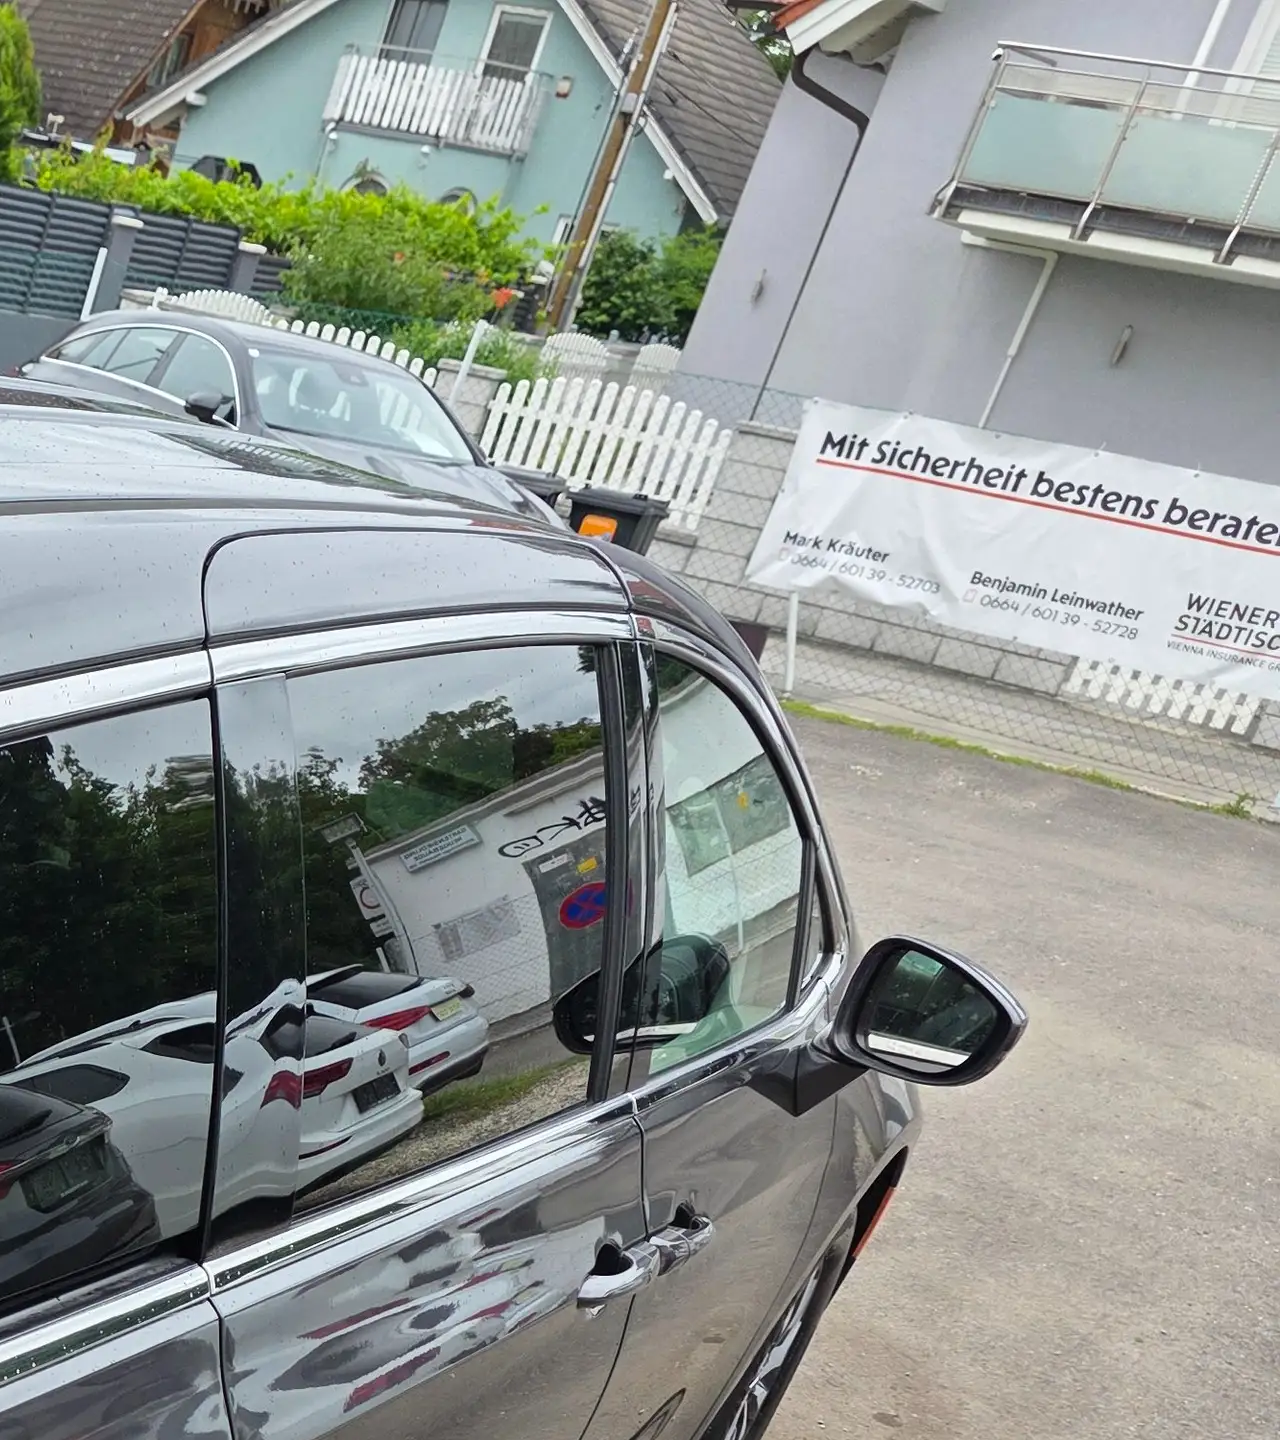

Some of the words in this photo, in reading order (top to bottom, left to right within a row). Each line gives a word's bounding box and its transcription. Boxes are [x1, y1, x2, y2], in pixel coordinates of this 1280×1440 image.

[819, 431, 870, 461] Mit
[870, 440, 1028, 493] Sicherheit
[1030, 471, 1159, 520] bestens
[1162, 497, 1280, 547] berate
[783, 530, 822, 550] Mark
[826, 538, 890, 563] Kräuter
[866, 567, 887, 582] 39
[896, 574, 941, 594] 52703
[969, 570, 1048, 600] Benjamin
[1050, 588, 1144, 621] Leinwather
[980, 594, 1019, 613] 0664
[1031, 606, 1059, 622] 601
[1060, 611, 1080, 626] 39
[1091, 619, 1138, 641] 52728
[1187, 592, 1280, 629] WIENER
[1174, 614, 1280, 651] STÄDTISC
[1166, 640, 1204, 656] VIENNA
[1206, 650, 1266, 668] INSURANCE
